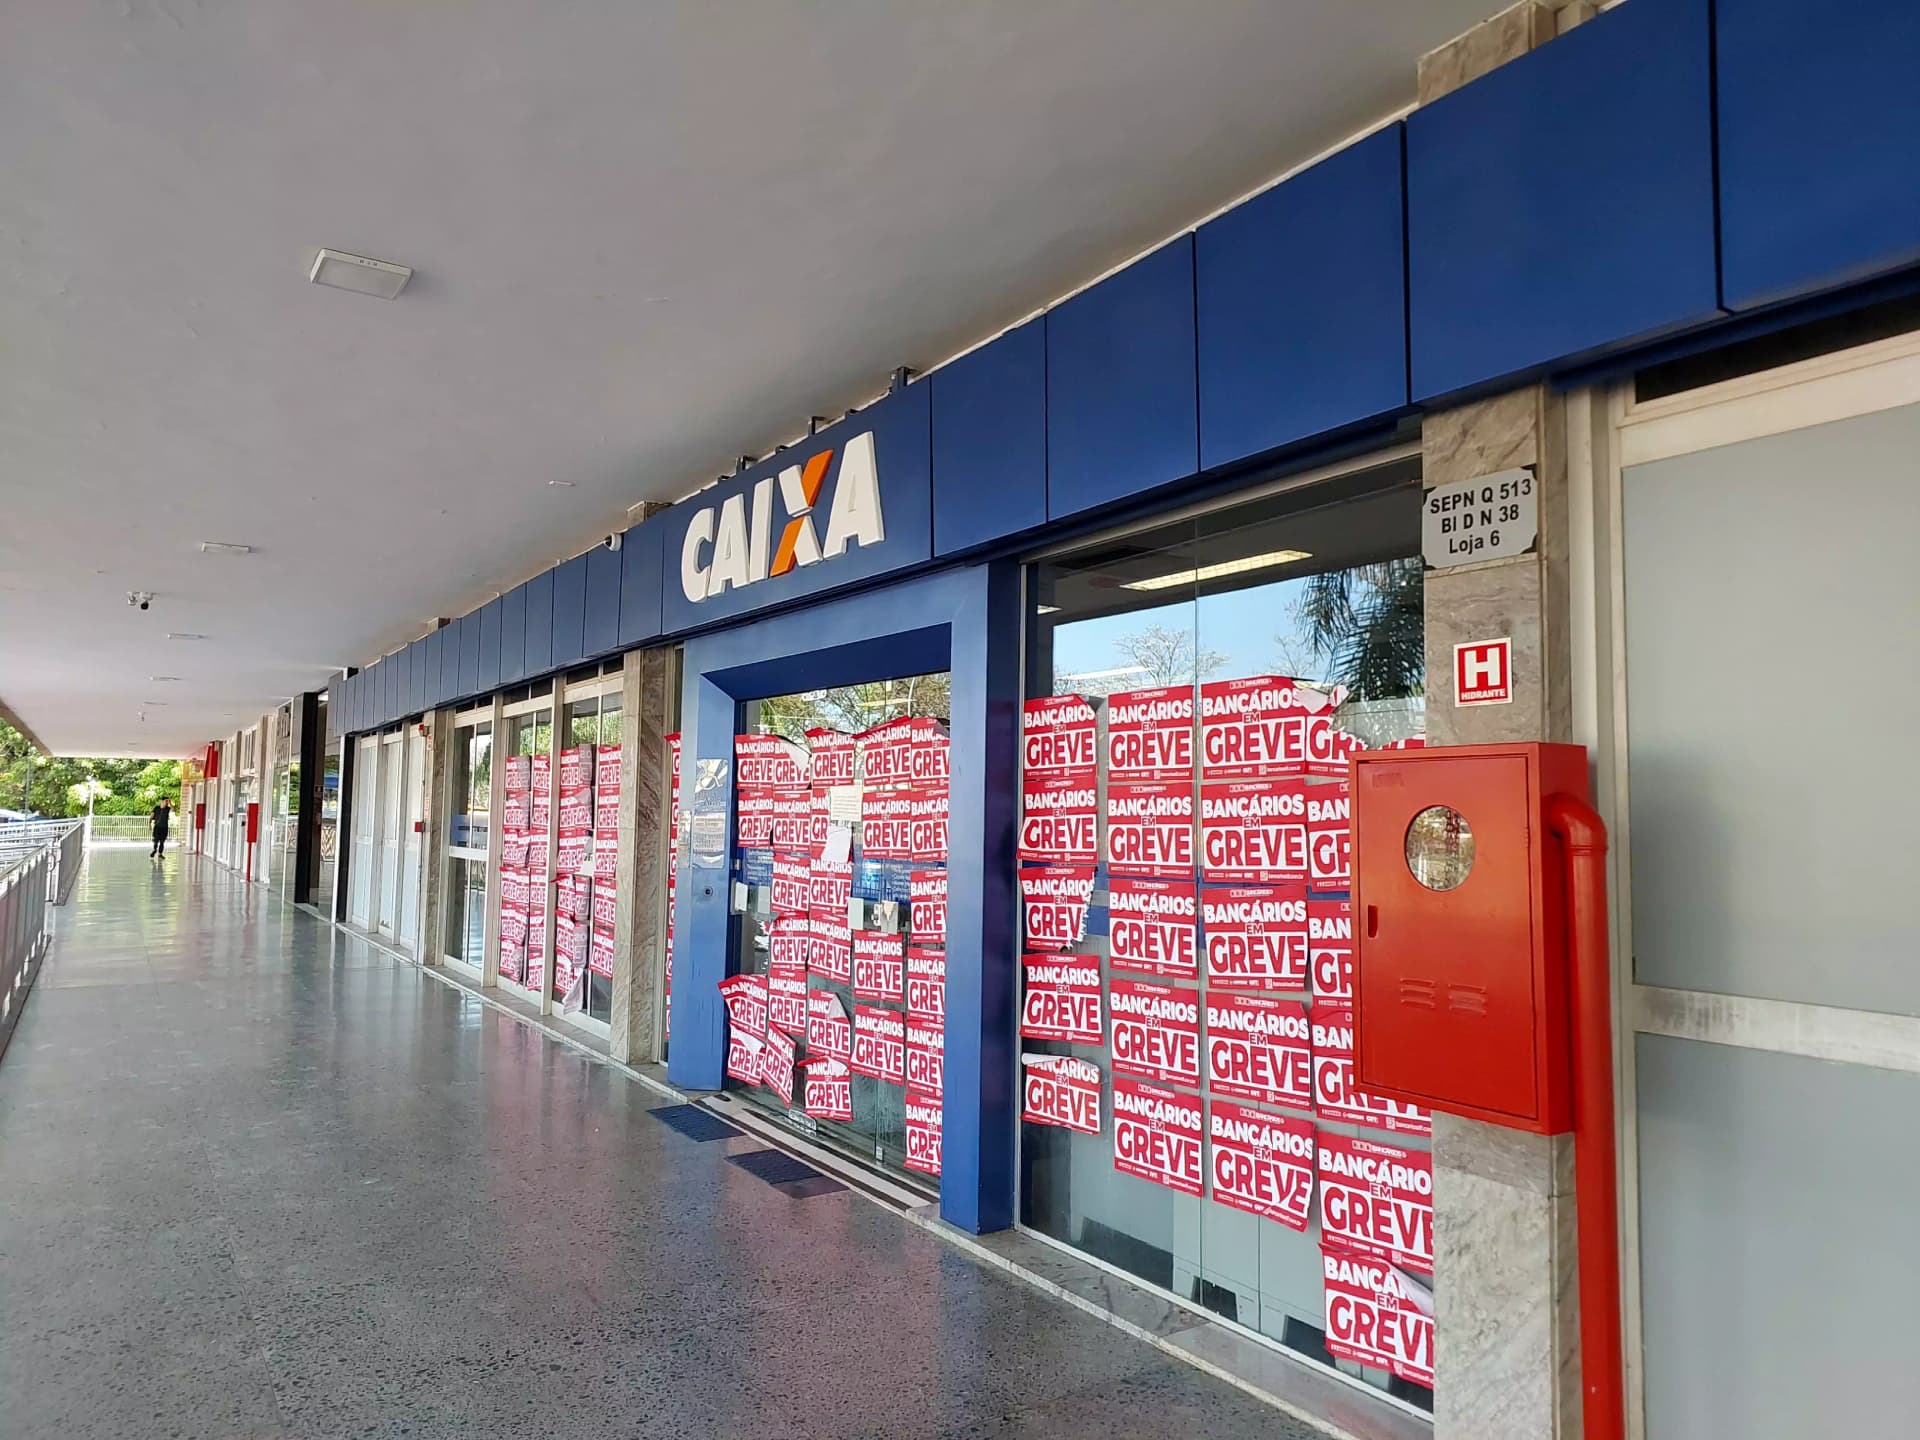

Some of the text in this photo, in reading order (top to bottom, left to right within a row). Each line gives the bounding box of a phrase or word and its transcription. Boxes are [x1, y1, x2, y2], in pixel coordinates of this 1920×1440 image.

[1430, 478, 1532, 514] SEPN Q 513
[682, 431, 885, 602] CAIXA
[1464, 513, 1474, 530] D
[1480, 509, 1492, 526] N
[1499, 504, 1519, 523] 38
[1450, 530, 1500, 555] Loja 6
[1464, 647, 1500, 689] H
[1461, 688, 1506, 700] HIDRANTE
[1024, 704, 1096, 728] BANCÁRIOS
[1108, 698, 1192, 724] BANCÁRIOS
[1244, 713, 1260, 724] EM
[1142, 722, 1156, 733] EM
[1026, 730, 1093, 767] GREVE
[1111, 730, 1190, 768] GREVE
[1206, 720, 1301, 764] GREVE
[740, 760, 772, 782] GREVE
[814, 752, 852, 778] GREVE
[865, 747, 910, 776] GREVE
[774, 800, 810, 814] BANCÁRIOS
[863, 799, 910, 815] BANCÁRIOS
[1025, 789, 1096, 809] BANCÁRIOS
[1108, 794, 1192, 816] BANCÁRIOS
[1202, 794, 1304, 819] BANCÁRIOS
[1054, 810, 1065, 818] EM
[1142, 818, 1155, 826] EM
[1244, 818, 1260, 828] EM
[774, 819, 809, 844] GREVE
[864, 822, 909, 848] GREVE
[1024, 818, 1094, 849] GREVE
[1110, 827, 1190, 863] GREVE
[1206, 829, 1304, 867] GREVE
[773, 880, 808, 910] GREVE
[811, 879, 850, 908] GREVE
[1055, 896, 1066, 904] EM
[1110, 892, 1195, 916] BANCÁRIOS
[1144, 914, 1158, 924] EM
[1204, 900, 1306, 924] BANCÁRIOS
[810, 920, 852, 940] BANCÁRIOS
[1112, 921, 1193, 965] GREVE
[1247, 924, 1263, 936] EM
[772, 938, 806, 962] GREVE
[810, 940, 848, 974] GREVE
[854, 940, 902, 956] BANCÁRIOS
[1210, 935, 1304, 974] GREVE
[856, 961, 900, 990] GREVE
[1028, 965, 1100, 987] BANCÁRIOS
[1057, 986, 1069, 994] EM
[730, 998, 765, 1033] GREVE
[770, 996, 804, 1027] GREVE
[1027, 992, 1099, 1030] GREVE
[1110, 992, 1198, 1024] BANCÁRIOS
[855, 1014, 904, 1038] BANCÁRIOS
[1146, 1018, 1160, 1028] EM
[1208, 1007, 1310, 1040] BANCÁRIOS
[810, 1020, 850, 1054] GREVE
[1114, 1022, 1195, 1073] GREVE
[1250, 1035, 1266, 1046] EM
[856, 1037, 902, 1073] GREVE
[1212, 1040, 1309, 1093] GREVE
[1057, 1076, 1068, 1086] EM
[807, 1083, 850, 1110] GREVE
[1028, 1079, 1098, 1129] GREVE
[1114, 1090, 1202, 1132] BANCÁRIOS
[1150, 1120, 1164, 1132] EM
[1211, 1115, 1314, 1160] BANCÁRIOS
[1117, 1122, 1200, 1180] GREVE
[1255, 1148, 1271, 1162] EM
[1216, 1149, 1310, 1215] GREVE
[1319, 1148, 1432, 1196] BANCÁRIO
[1372, 1185, 1392, 1200] EM
[1378, 1296, 1397, 1311] EM
